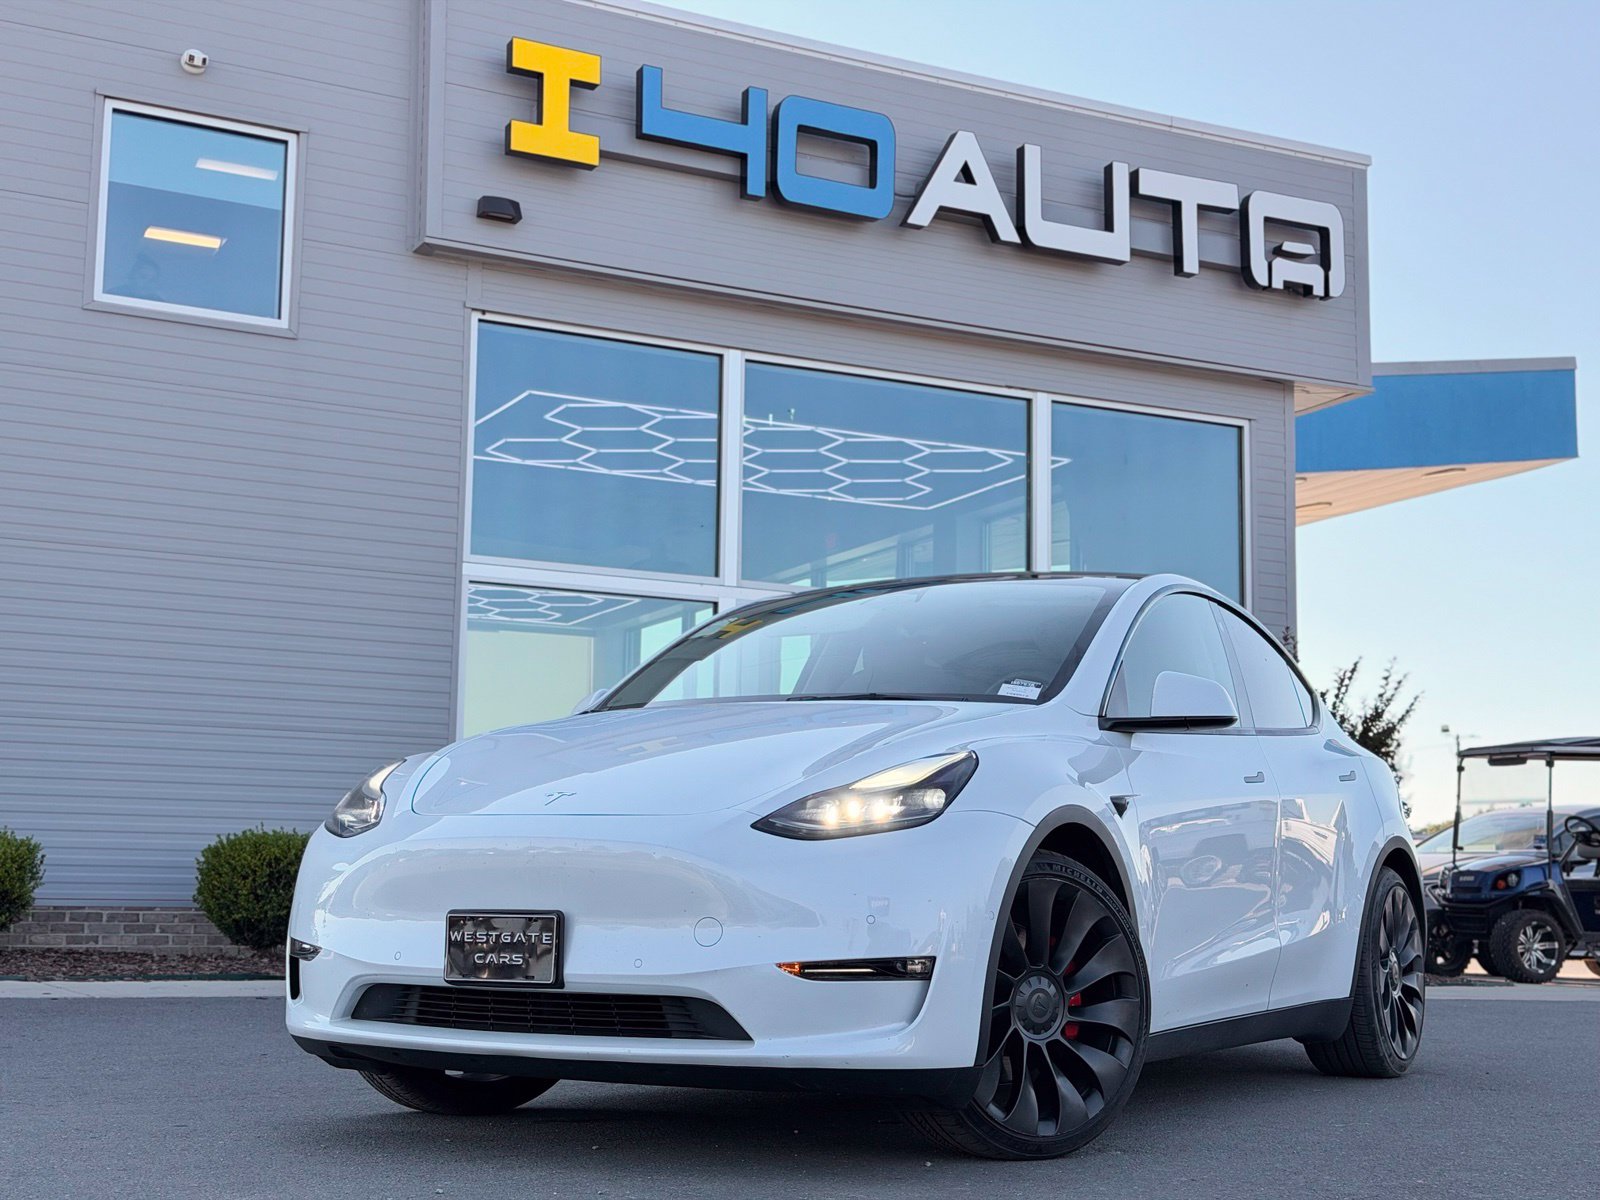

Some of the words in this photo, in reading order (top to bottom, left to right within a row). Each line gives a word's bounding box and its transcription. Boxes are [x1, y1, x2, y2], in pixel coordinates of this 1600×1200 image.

[901, 129, 1346, 300] AUTO
[1052, 864, 1103, 893] MICHELIN
[449, 930, 553, 944] WESTGATE
[474, 953, 524, 965] CARS
